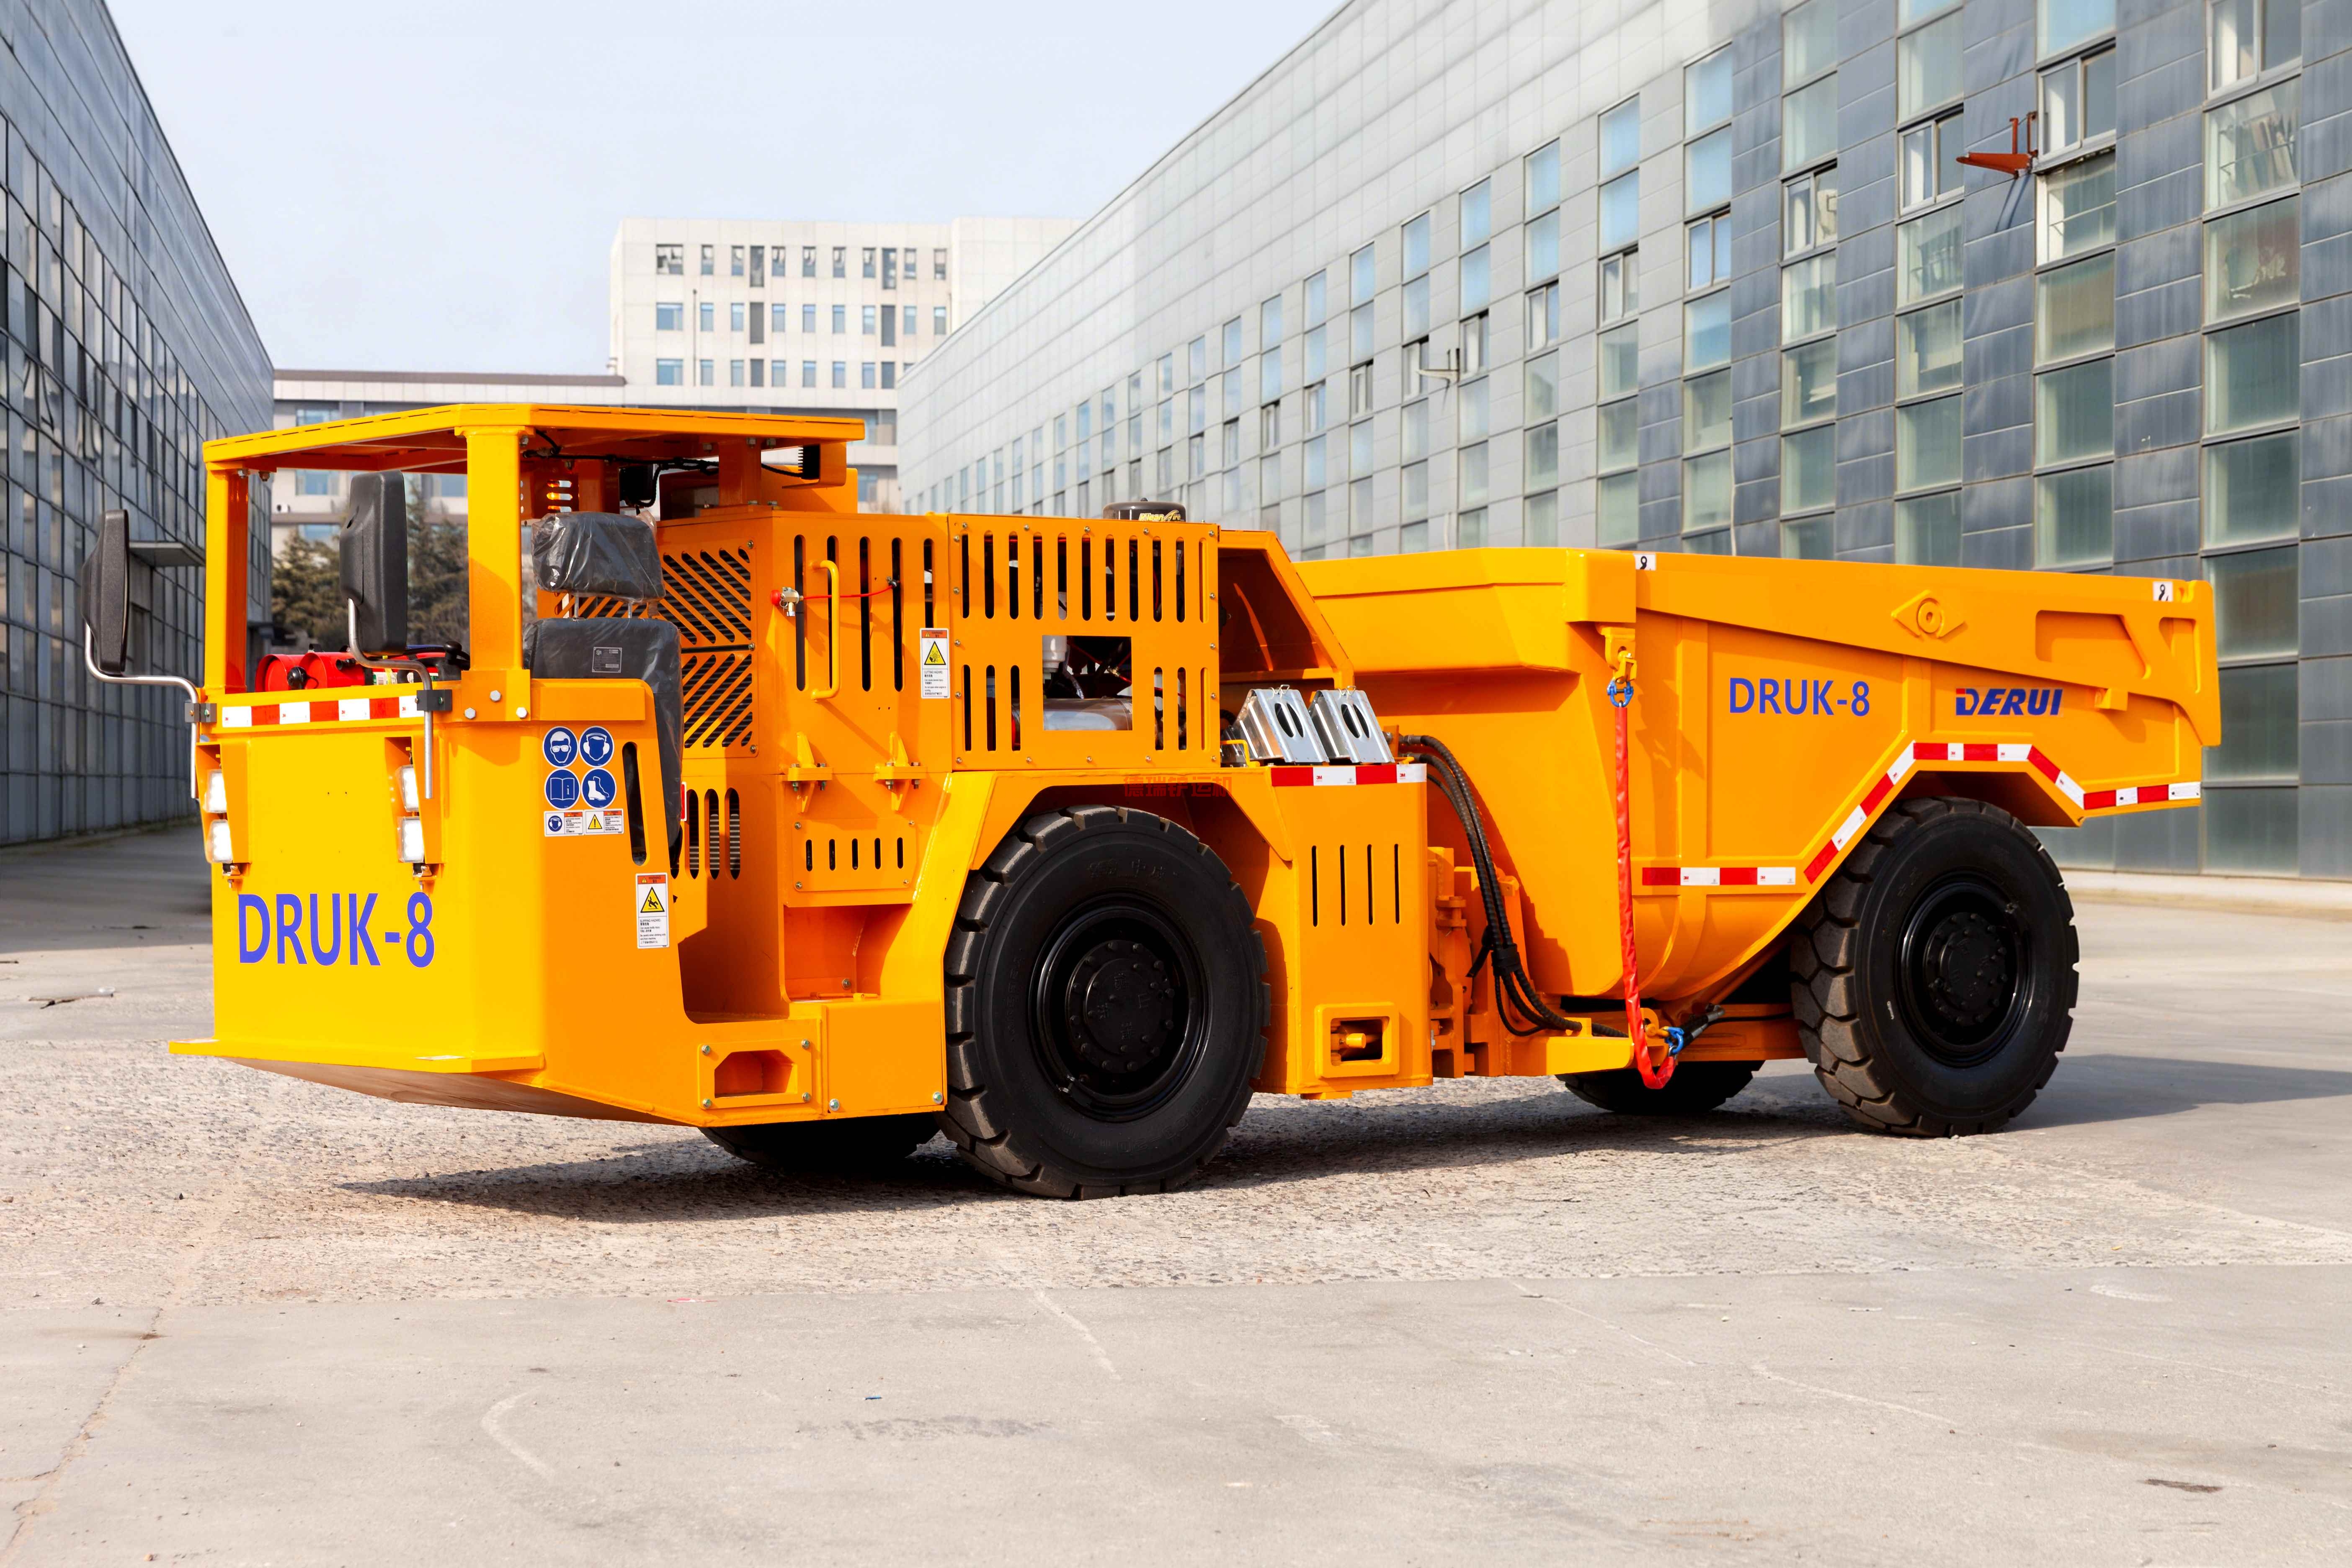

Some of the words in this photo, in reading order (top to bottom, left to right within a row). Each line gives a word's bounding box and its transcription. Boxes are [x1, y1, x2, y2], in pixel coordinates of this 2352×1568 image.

[1729, 678, 1870, 717] DRUK-8
[1955, 688, 2063, 715] DERUI
[238, 892, 435, 968] DRUK-8
